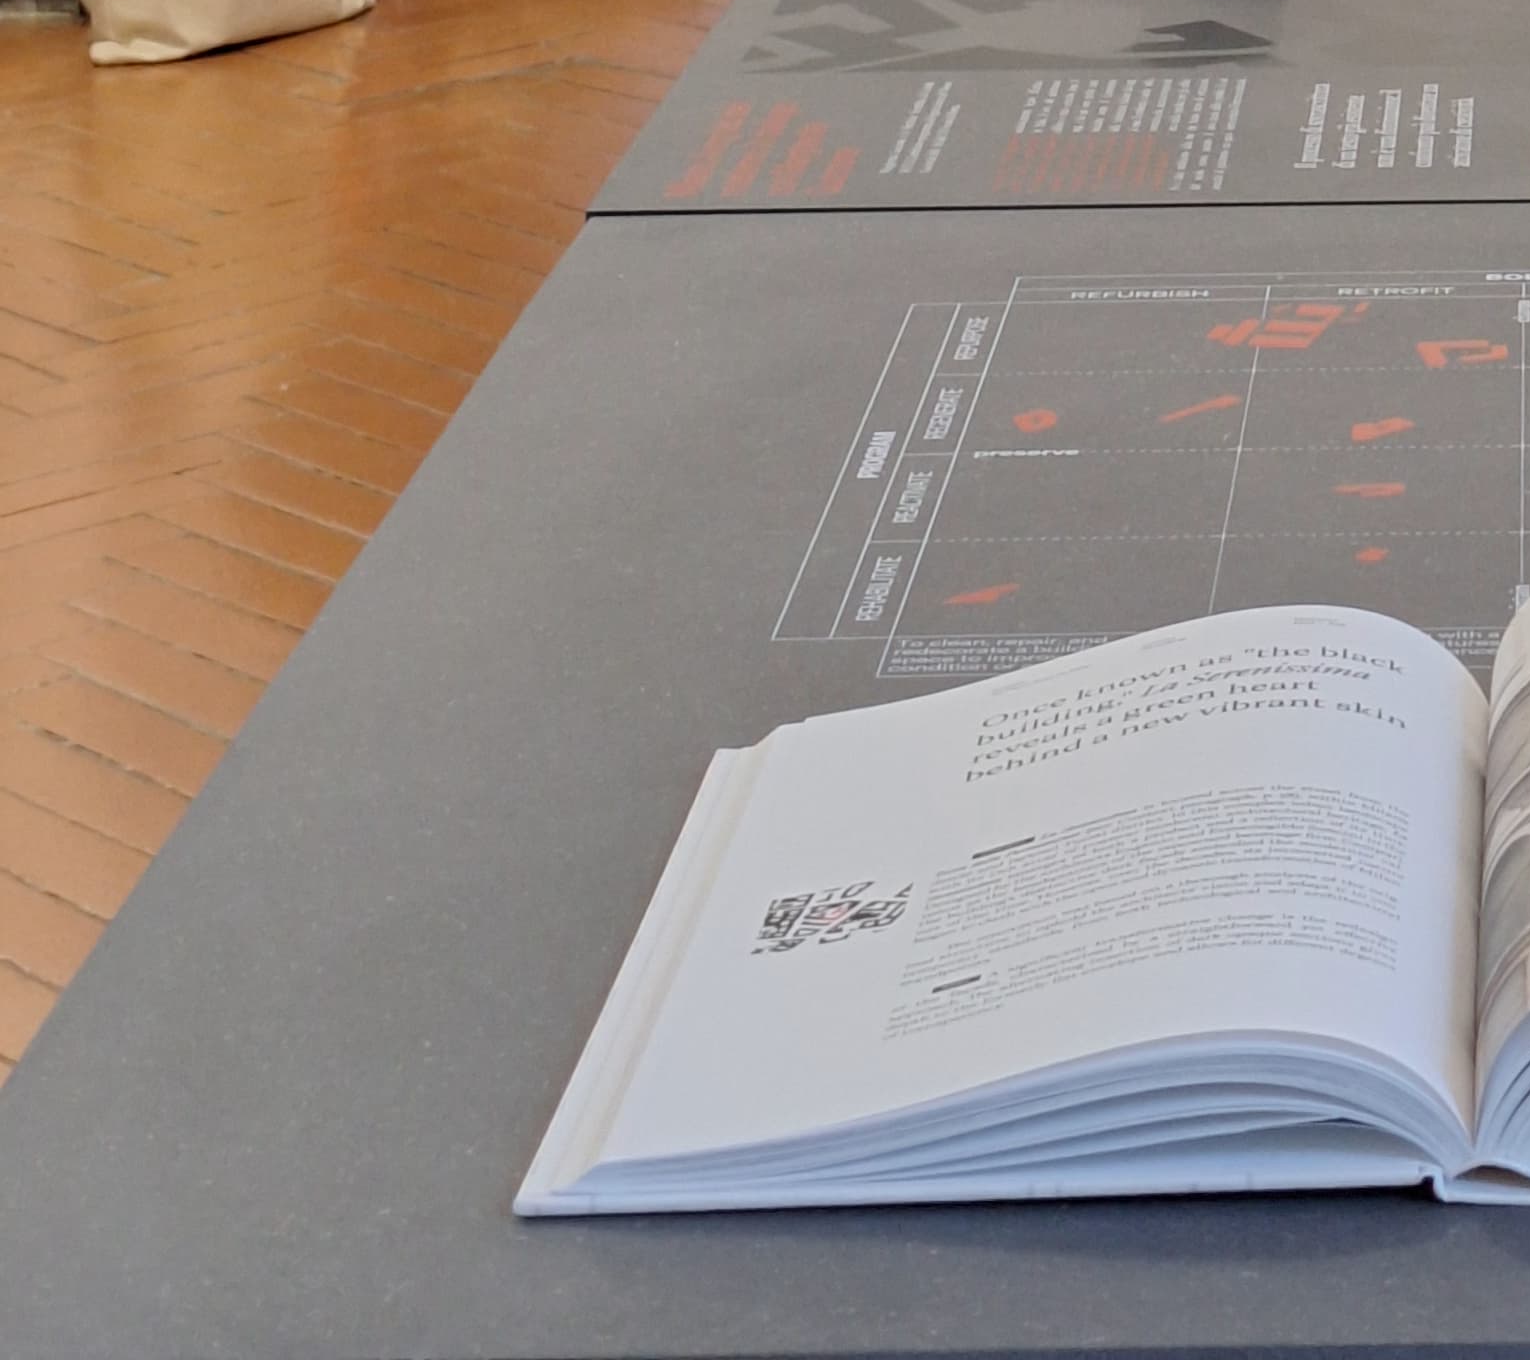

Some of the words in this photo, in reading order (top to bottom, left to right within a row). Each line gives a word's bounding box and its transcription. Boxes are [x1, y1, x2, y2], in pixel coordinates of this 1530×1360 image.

[1070, 288, 1210, 300] REFURBISH
[1337, 285, 1456, 297] RETROFIT
[923, 386, 964, 440] REGENERATE
[856, 431, 897, 479] PROGRAM
[973, 449, 1080, 459] preserve
[892, 470, 933, 524] REACTIVATE
[855, 554, 902, 622] REHABILITATE
[901, 638, 923, 647] To
[982, 698, 1067, 728] Once
[1076, 664, 1188, 701] known
[1198, 654, 1233, 667] as
[1320, 646, 1404, 675] black
[1141, 682, 1180, 699] La
[1185, 662, 1371, 686] Serenissima
[965, 737, 1082, 782] behind
[1091, 733, 1109, 745] a
[1120, 712, 1190, 737] new
[1199, 697, 1327, 717] vibrant
[1335, 701, 1406, 730] skin
[972, 723, 1088, 765] reveals
[1096, 716, 1113, 727] a
[1122, 688, 1216, 722] green
[1228, 679, 1320, 695] heart
